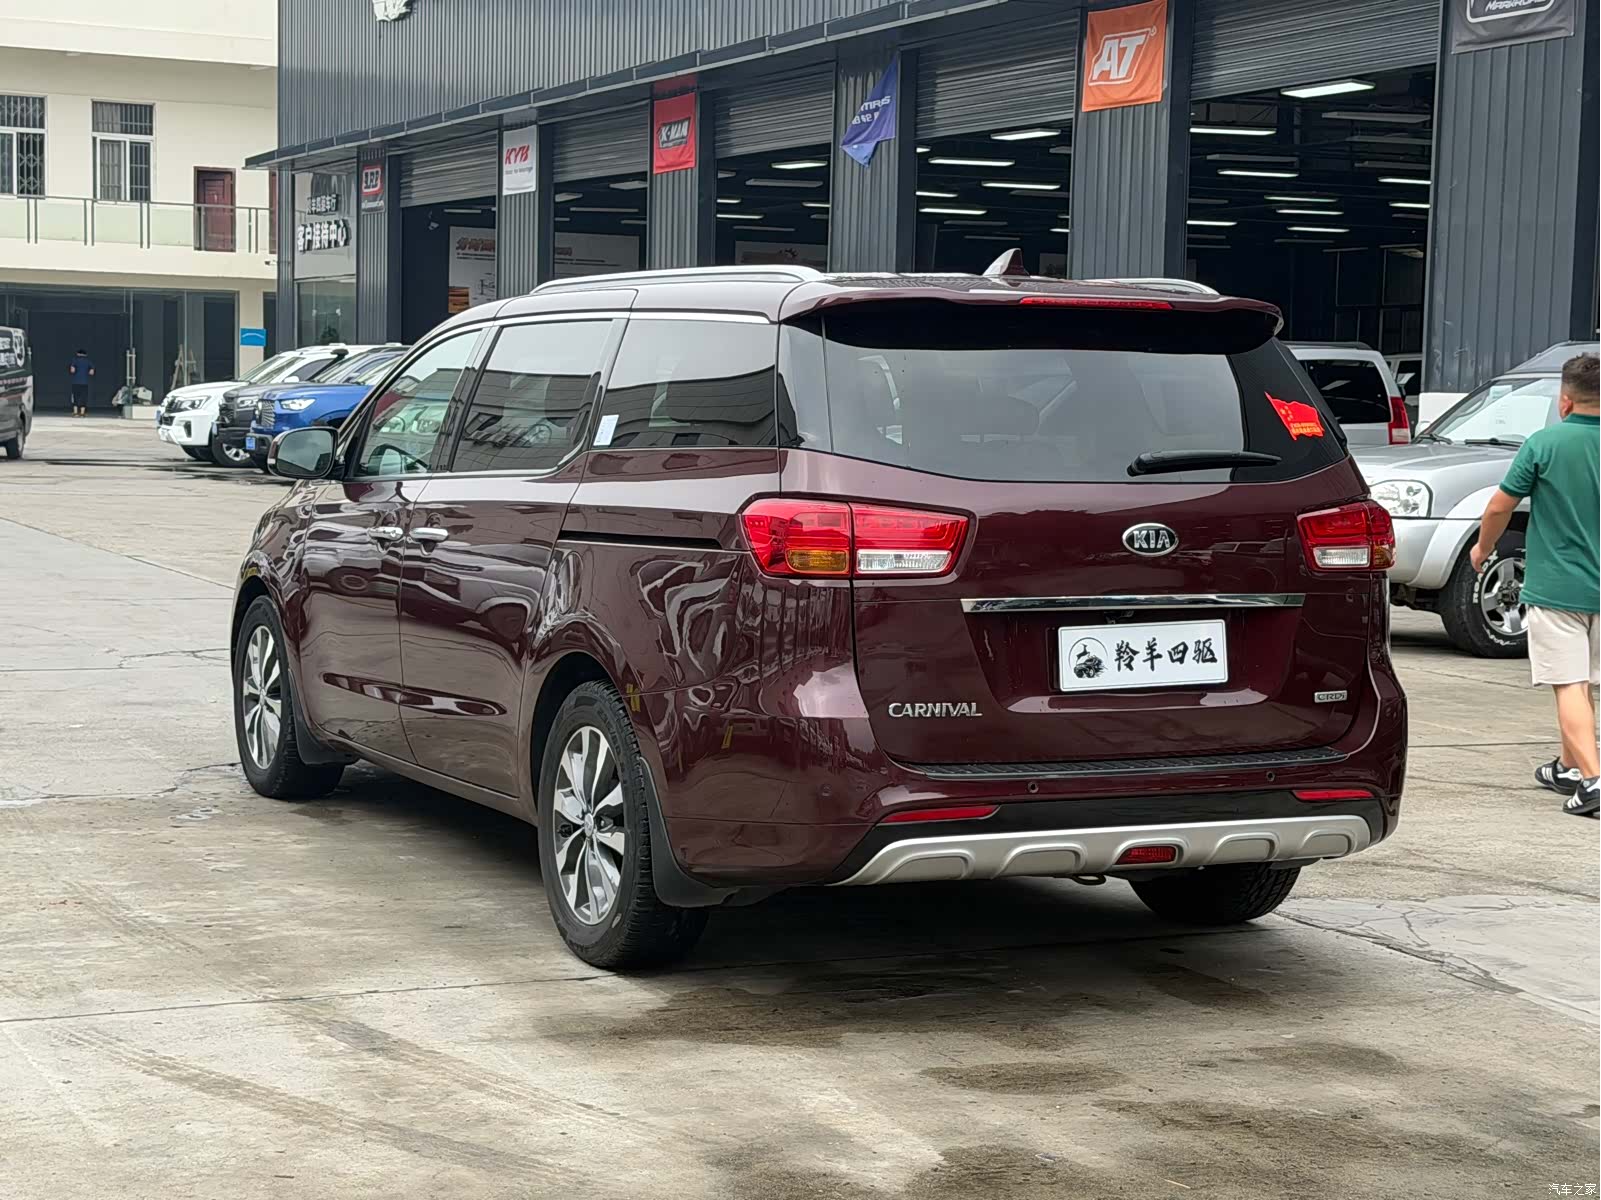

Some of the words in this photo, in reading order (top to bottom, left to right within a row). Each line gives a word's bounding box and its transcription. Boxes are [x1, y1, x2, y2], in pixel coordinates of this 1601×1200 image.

[1092, 34, 1147, 81] AT
[505, 145, 530, 165] KYB
[297, 219, 347, 251] 客户接待中心
[1132, 530, 1170, 549] KIA
[1114, 637, 1218, 672] 羚羊四驱
[888, 702, 983, 718] CARNIVAL
